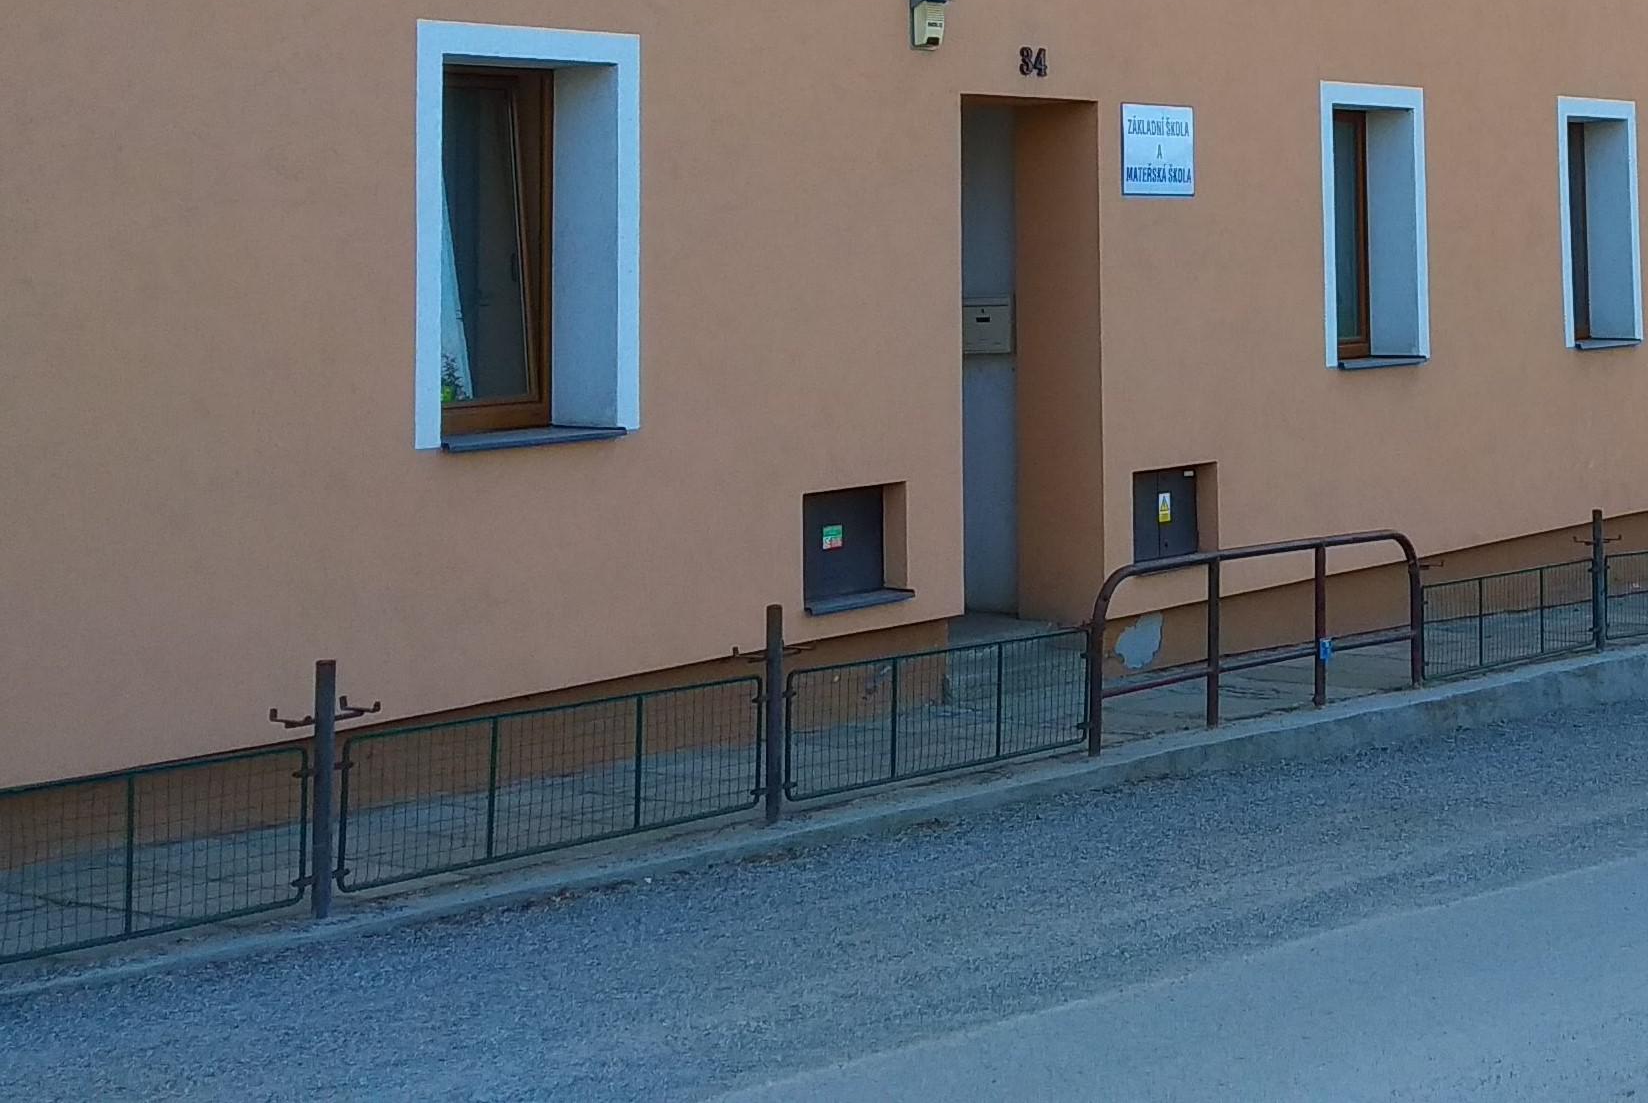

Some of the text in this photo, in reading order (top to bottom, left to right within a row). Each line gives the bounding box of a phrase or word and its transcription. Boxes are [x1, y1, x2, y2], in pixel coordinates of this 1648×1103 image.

[1127, 115, 1190, 137] ZÁKLADNÍ ŠKOLA
[1156, 144, 1163, 159] A
[1126, 163, 1192, 184] MATEŘSKÁ ŠKOLA
